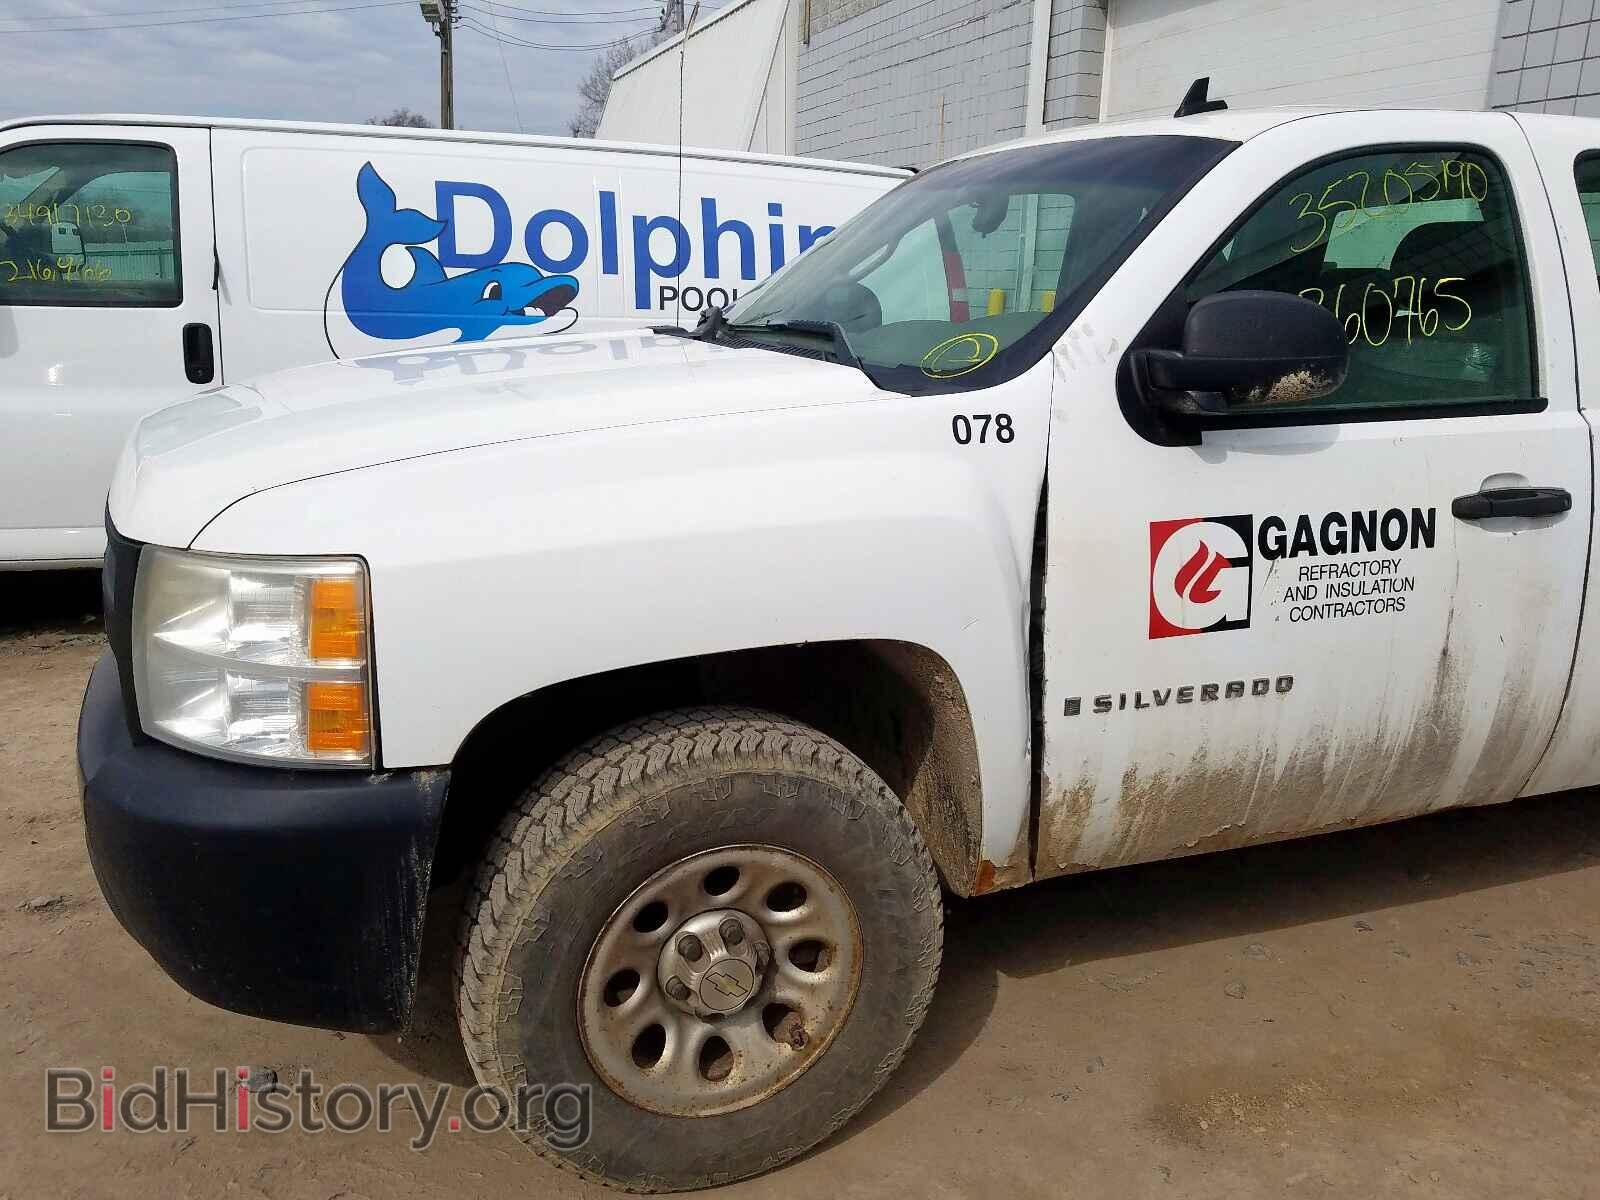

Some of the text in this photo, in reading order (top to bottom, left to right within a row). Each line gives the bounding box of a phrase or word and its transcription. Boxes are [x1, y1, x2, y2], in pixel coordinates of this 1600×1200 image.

[1288, 159, 1488, 253] 35205190
[951, 413, 1015, 445] 078
[1257, 507, 1437, 560] GAGNON
[1298, 558, 1402, 582] REFRACTORY
[1283, 576, 1416, 602] AND INSULATION
[1288, 596, 1406, 623] CONTRACTORS
[1092, 674, 1295, 714] SILVERADO
